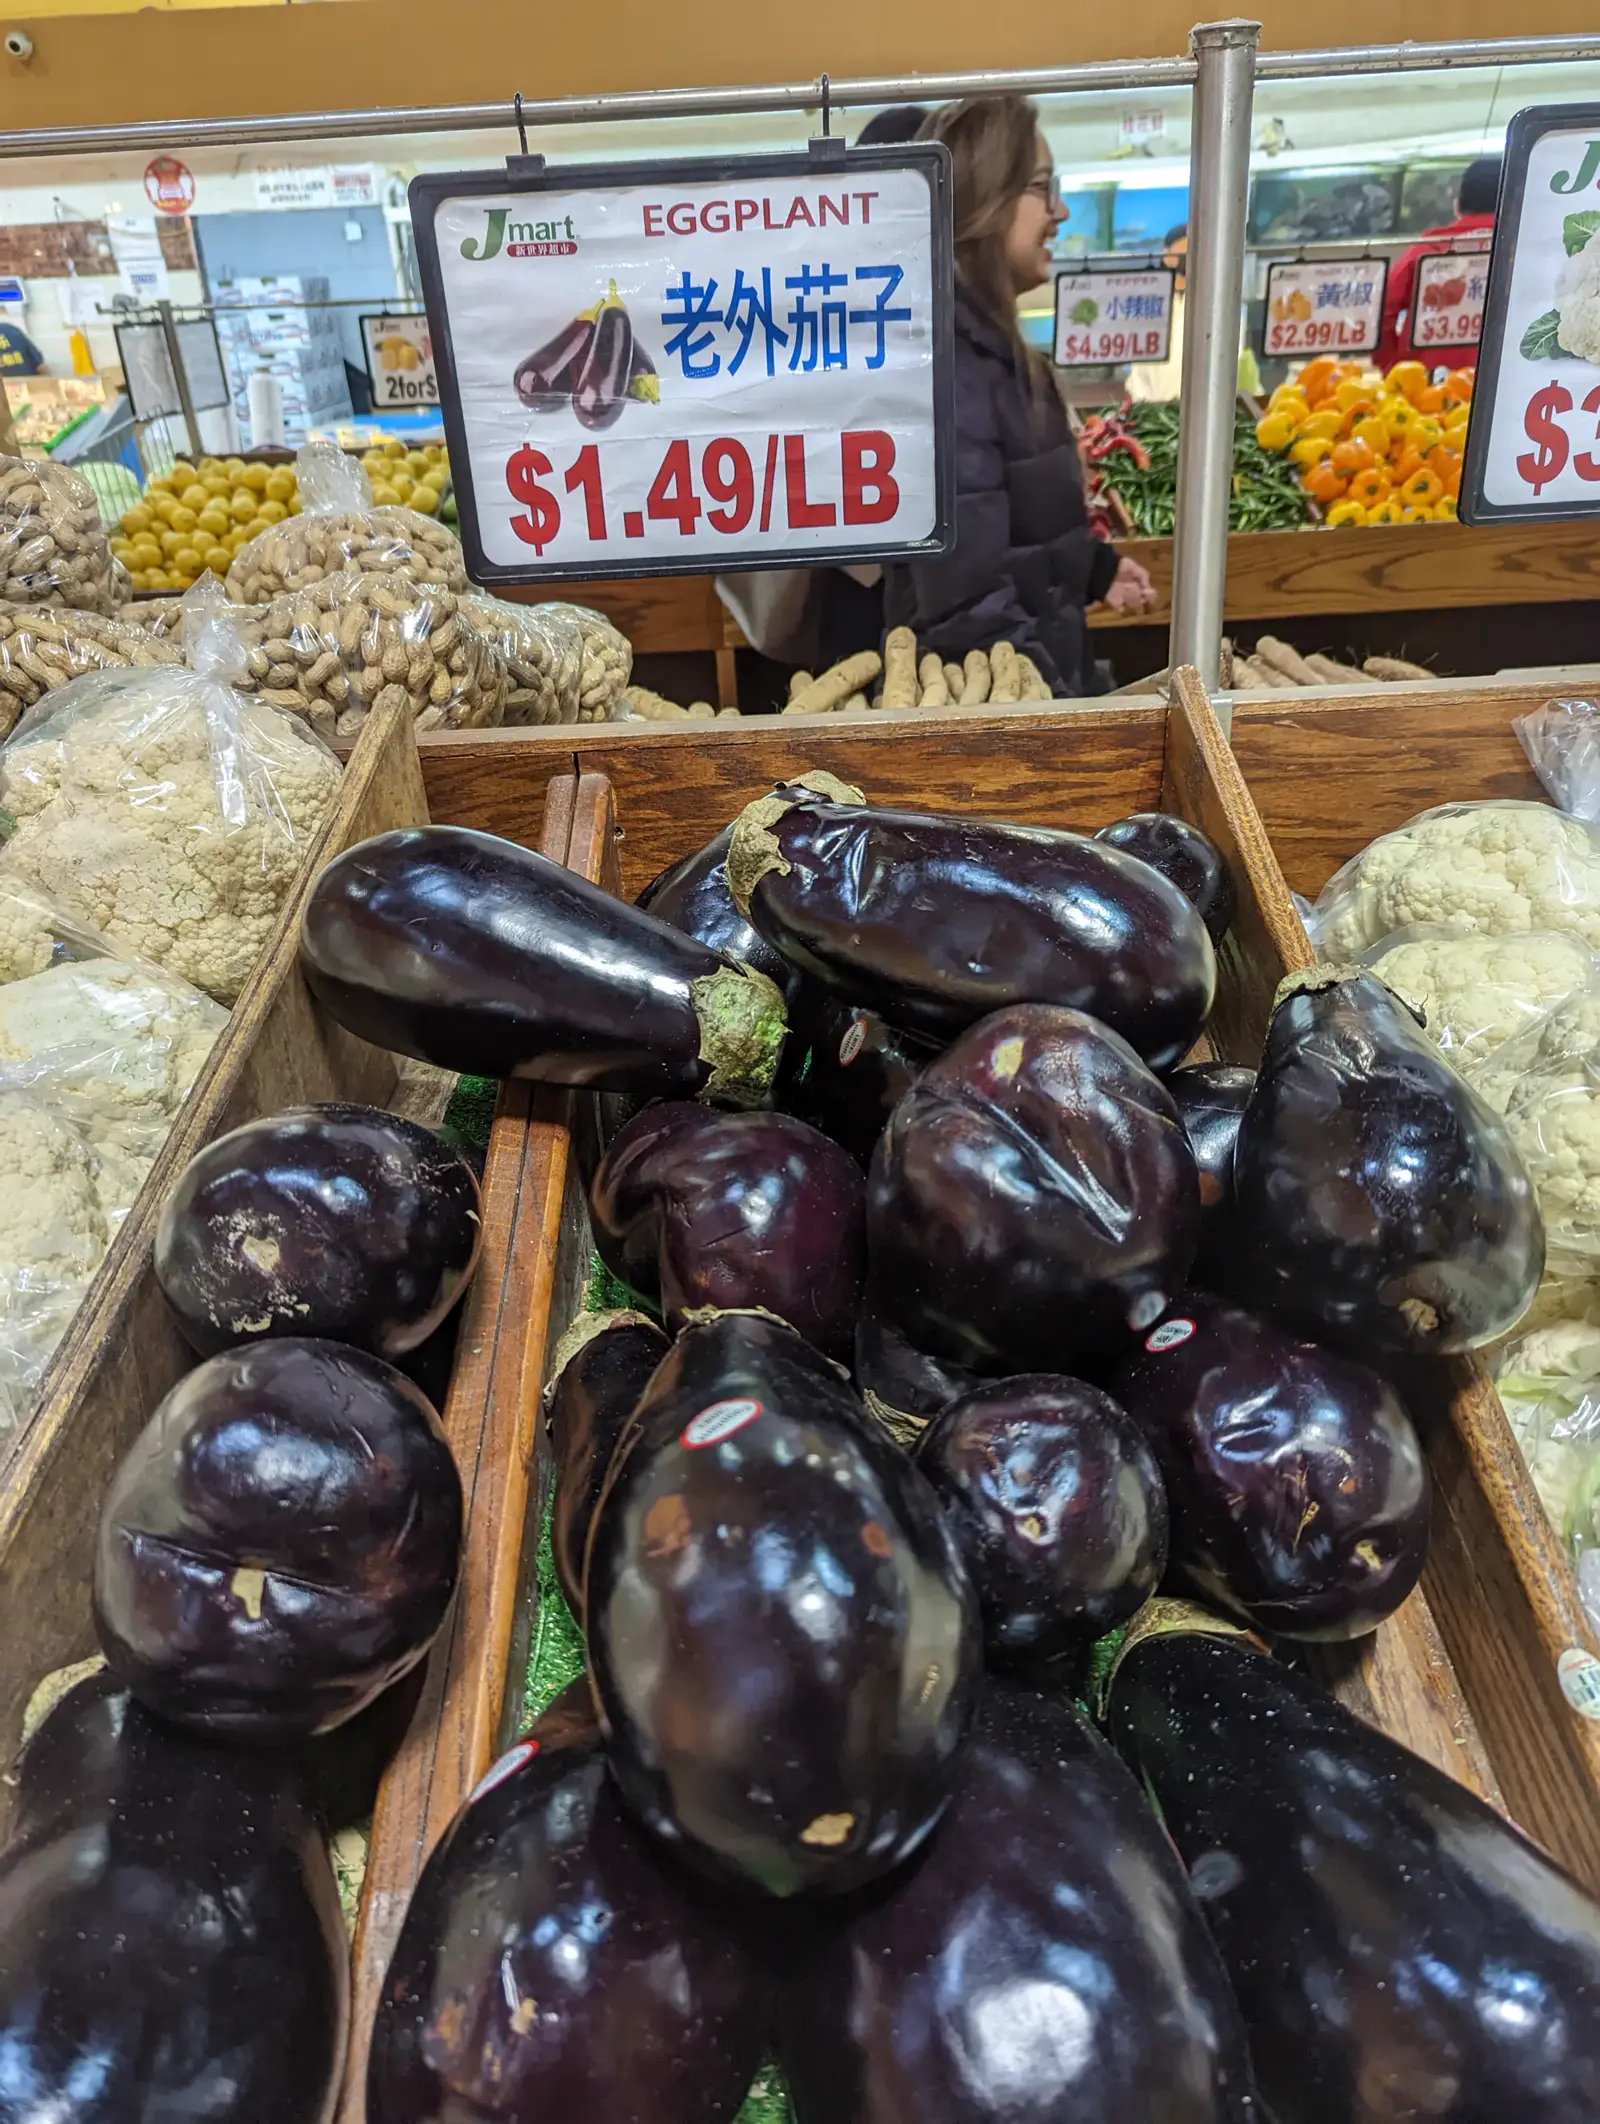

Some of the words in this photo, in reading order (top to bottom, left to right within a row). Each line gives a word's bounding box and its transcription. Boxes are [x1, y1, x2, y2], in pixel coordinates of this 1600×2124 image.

[460, 208, 575, 261] Jmart
[642, 192, 879, 237] EGGPLANT
[515, 242, 570, 257] 新世界超市
[661, 263, 912, 379] 老外茄子
[1270, 320, 1367, 349] $2.99/LB
[1065, 331, 1160, 362] $4.99/LB
[505, 430, 900, 556] $1.49/LB
